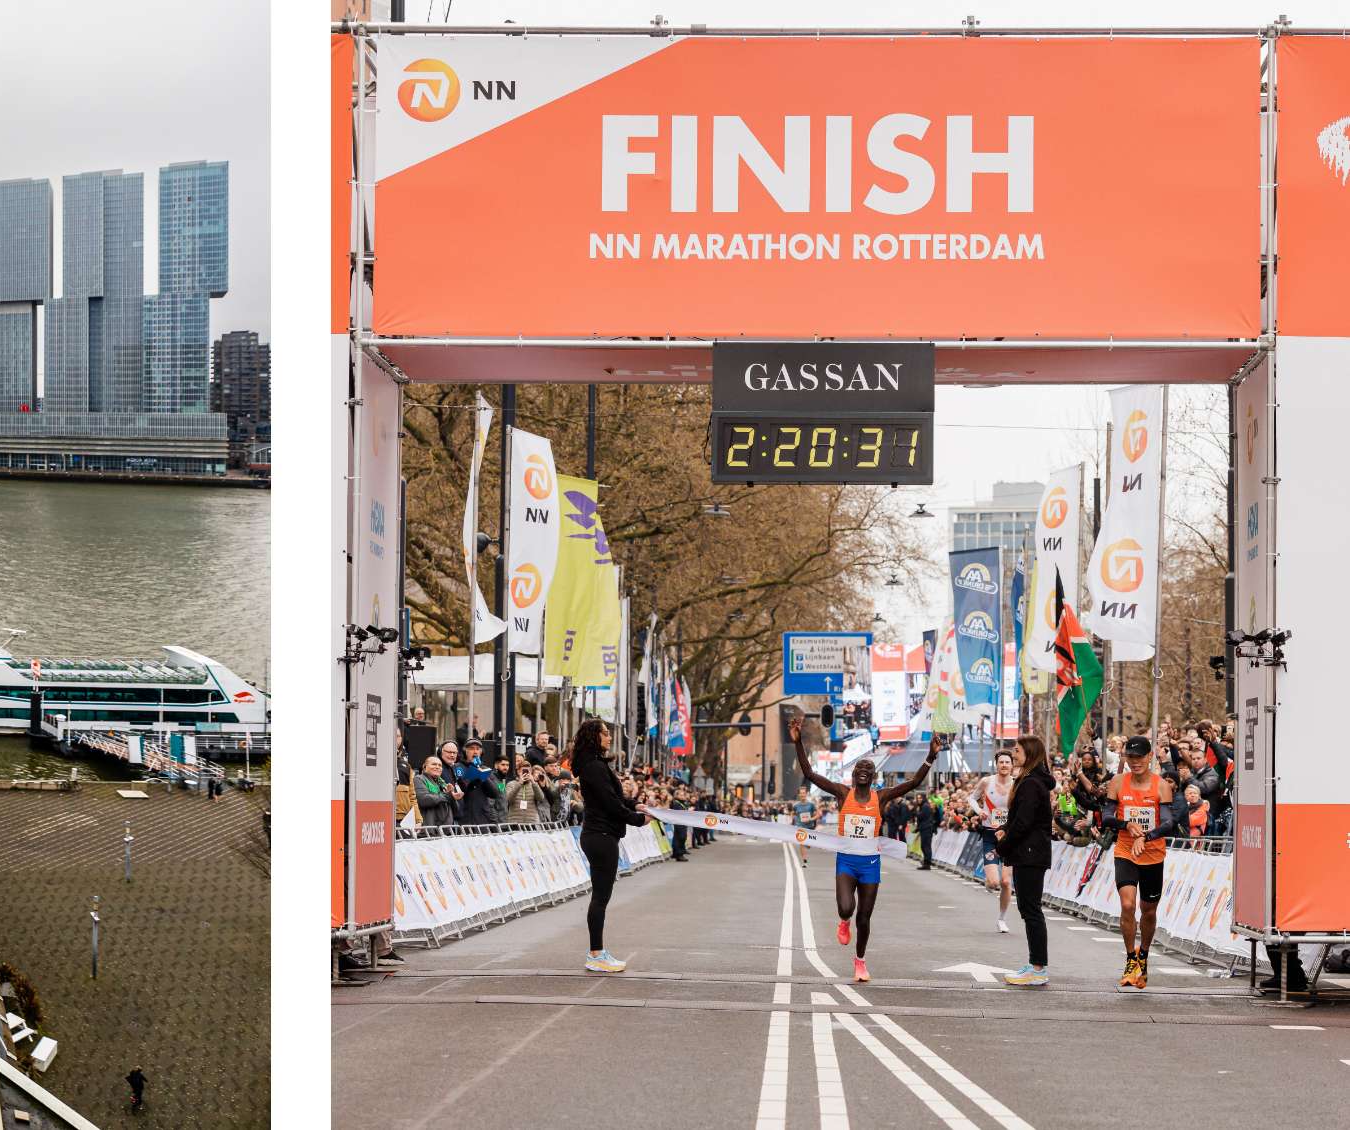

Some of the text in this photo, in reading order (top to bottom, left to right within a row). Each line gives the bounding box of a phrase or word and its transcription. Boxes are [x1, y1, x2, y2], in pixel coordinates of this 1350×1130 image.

[472, 80, 516, 100] NN
[601, 113, 1035, 215] FINISH
[589, 233, 1045, 260] NN MARATHON ROTTERDAM
[744, 363, 903, 391] GASSAN
[727, 427, 919, 467] 2:20:31
[525, 507, 549, 524] NN
[601, 645, 618, 676] TBI
